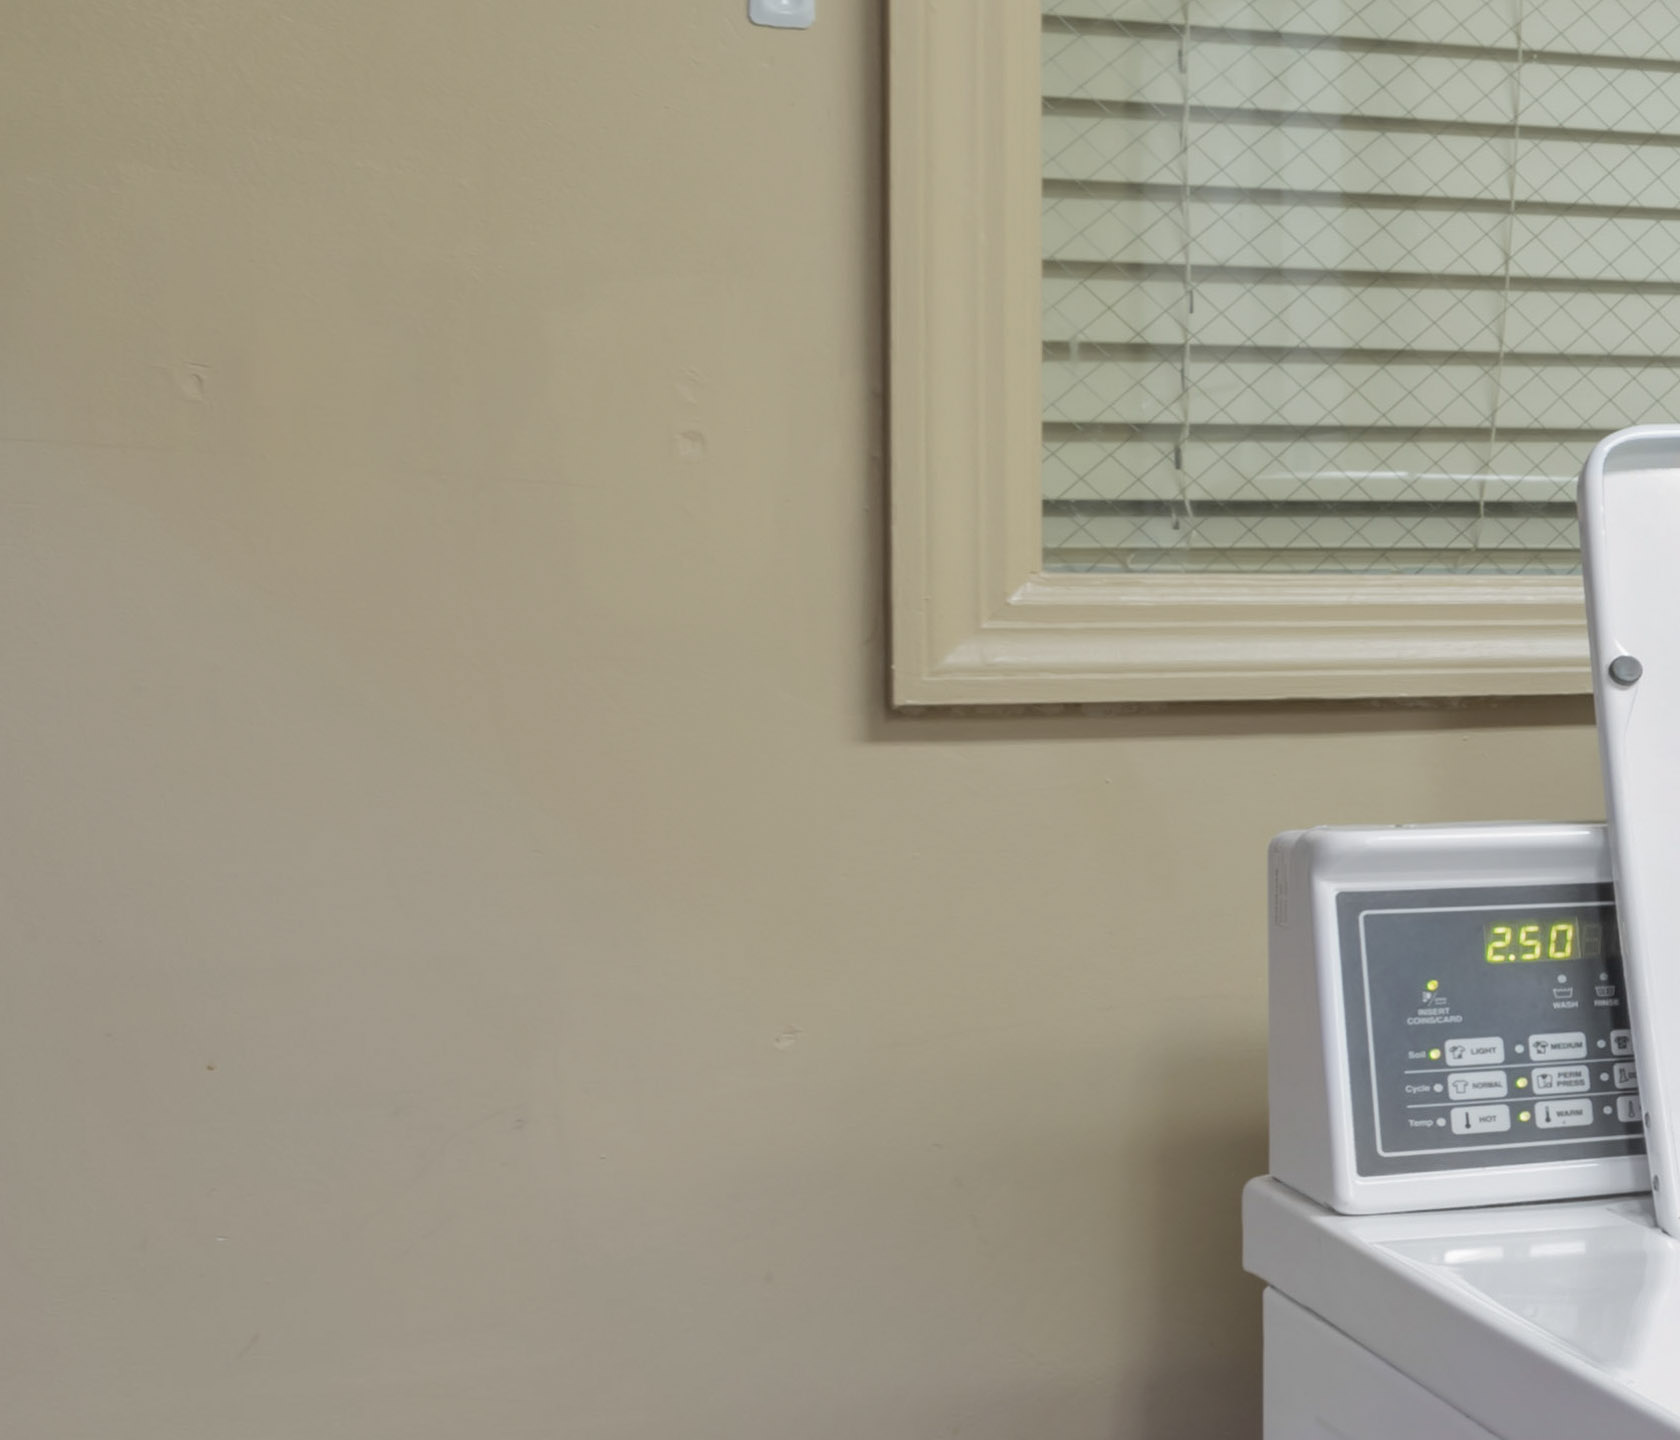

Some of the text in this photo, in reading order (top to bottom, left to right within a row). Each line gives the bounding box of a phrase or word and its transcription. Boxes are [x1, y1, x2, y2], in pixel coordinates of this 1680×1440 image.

[1486, 923, 1574, 962] 2.50
[1552, 1000, 1579, 1009] WASH
[1417, 1007, 1450, 1016] INSERT
[1407, 1015, 1463, 1025] COINS/CARD
[1551, 1041, 1583, 1051] MEDIUM
[1408, 1050, 1426, 1059] Soil
[1470, 1046, 1497, 1056] LIGHT
[1557, 1071, 1582, 1079] PERM
[1471, 1081, 1503, 1090] NORMAL
[1557, 1079, 1585, 1088] PRESS
[1405, 1084, 1431, 1094] Cycle
[1556, 1109, 1583, 1118] WARM
[1408, 1118, 1434, 1128] Temp
[1479, 1115, 1497, 1123] HOT
